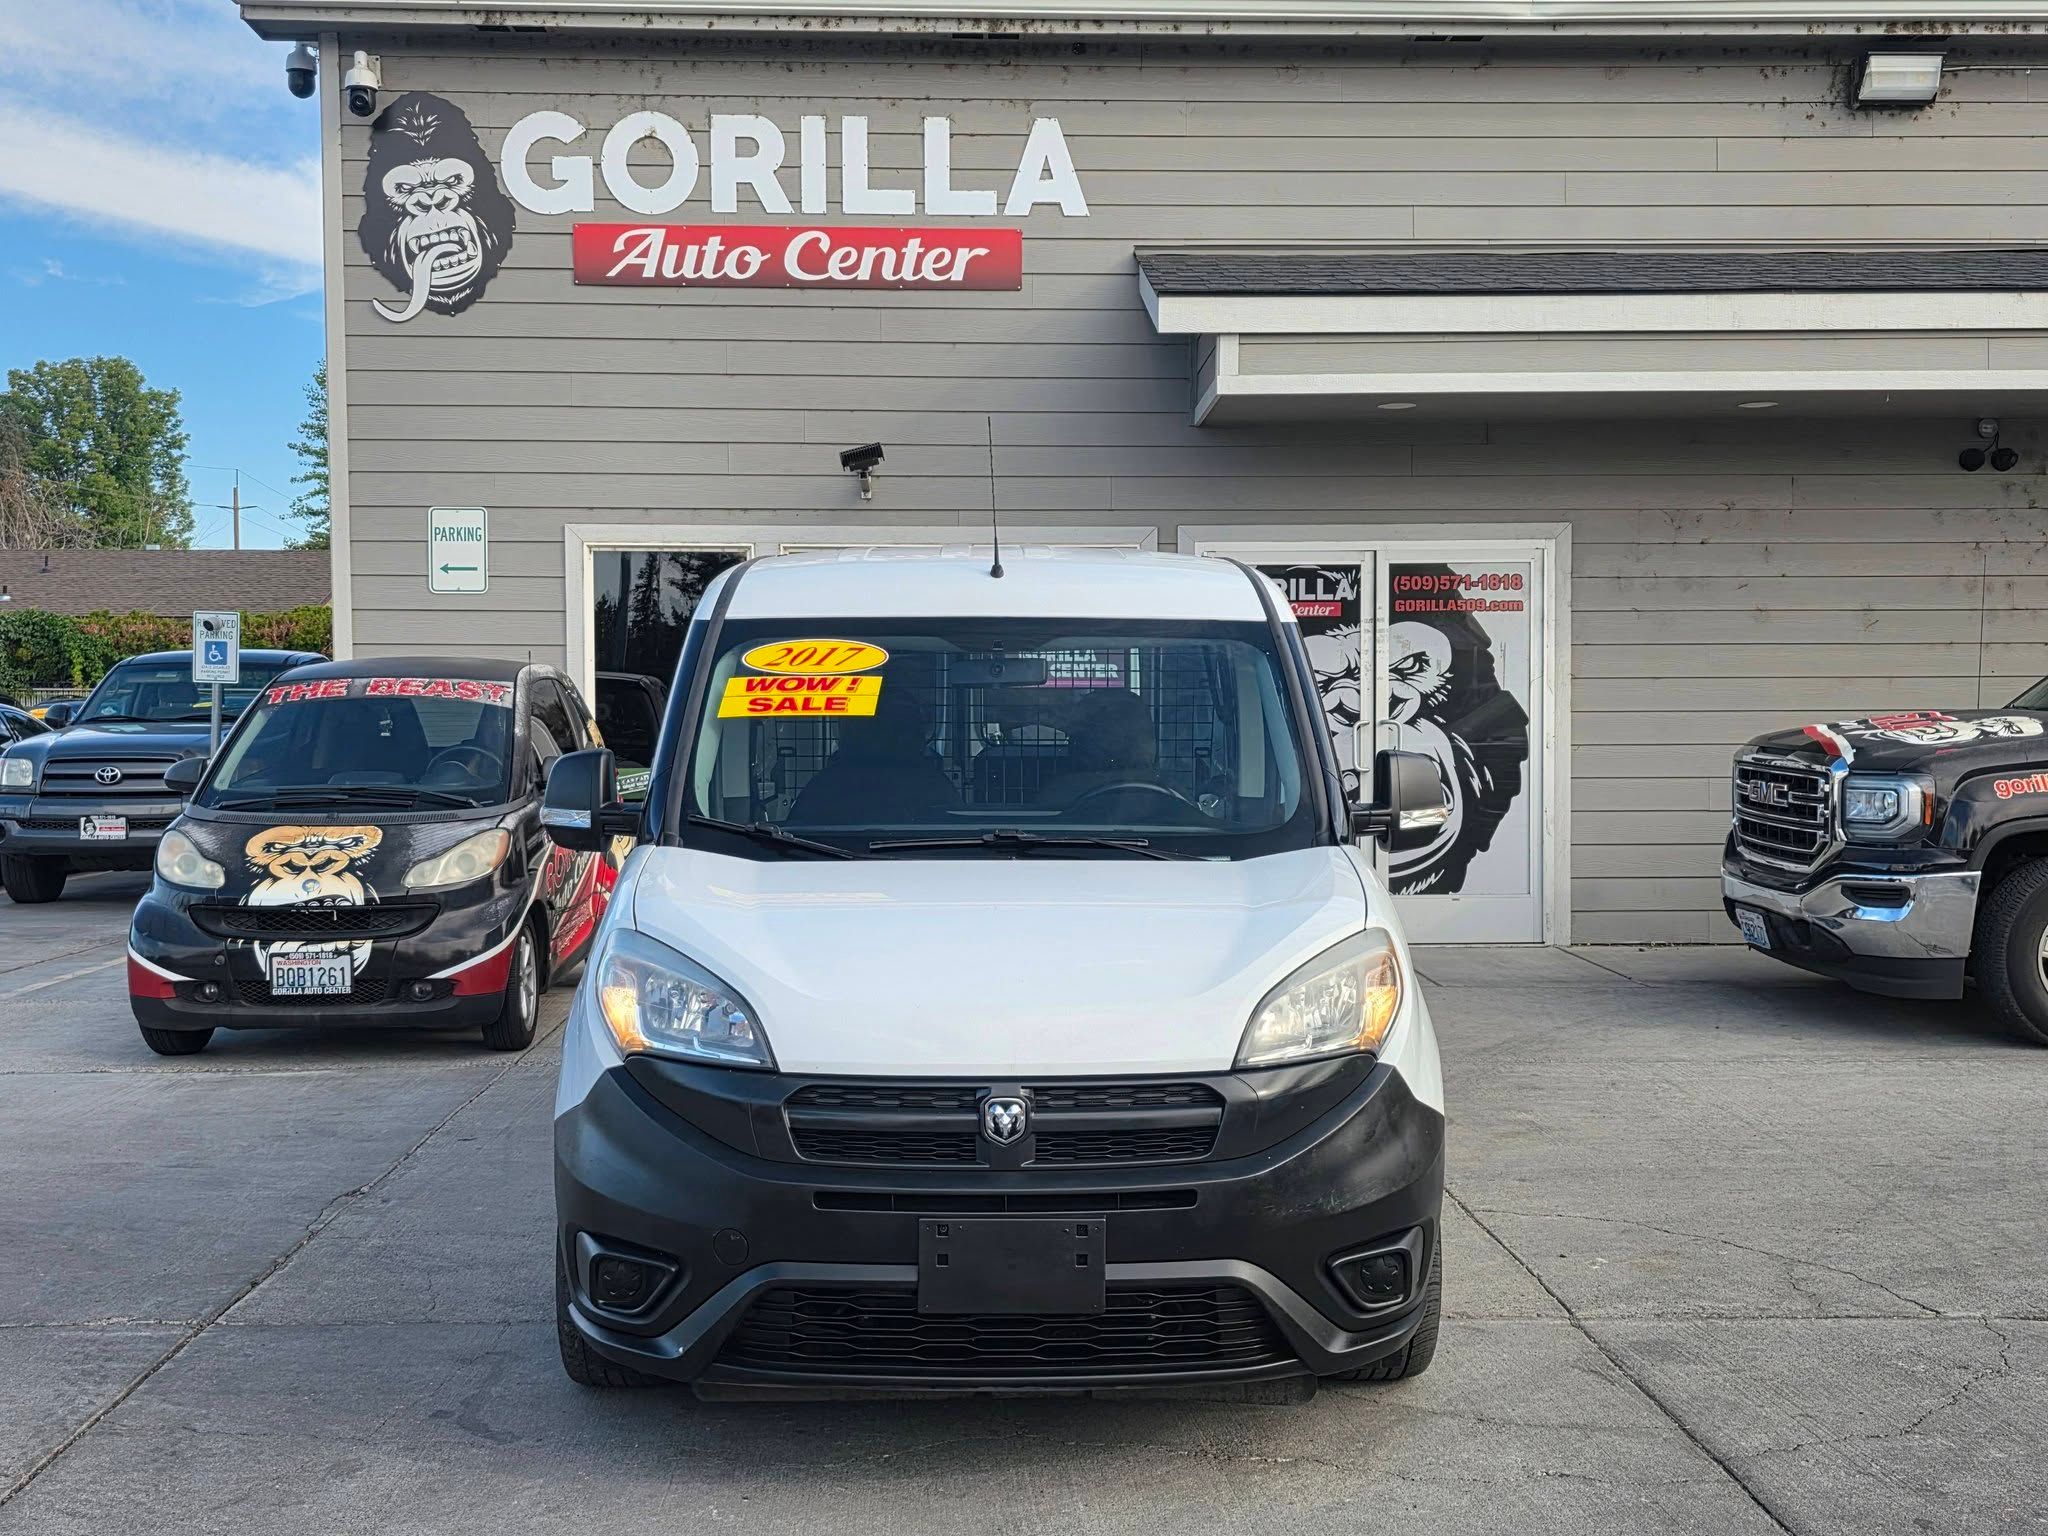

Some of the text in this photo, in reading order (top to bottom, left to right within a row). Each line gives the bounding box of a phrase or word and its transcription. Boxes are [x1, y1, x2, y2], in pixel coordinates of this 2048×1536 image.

[500, 109, 1090, 217] GORILLA
[604, 227, 991, 282] Auto Center
[434, 526, 482, 542] PARKING
[1393, 573, 1523, 594] (509)571-1818
[1394, 598, 1524, 612] GORILLA509.com
[200, 630, 234, 640] PARKING
[763, 646, 868, 667] 2017
[1049, 663, 1119, 678] CENTER
[266, 677, 513, 705] THE BEAST
[746, 697, 850, 713] SALE
[1748, 779, 1789, 807] GMC
[276, 967, 346, 987] BQB1261
[272, 986, 351, 996] GORILLA AUTO CENTER
